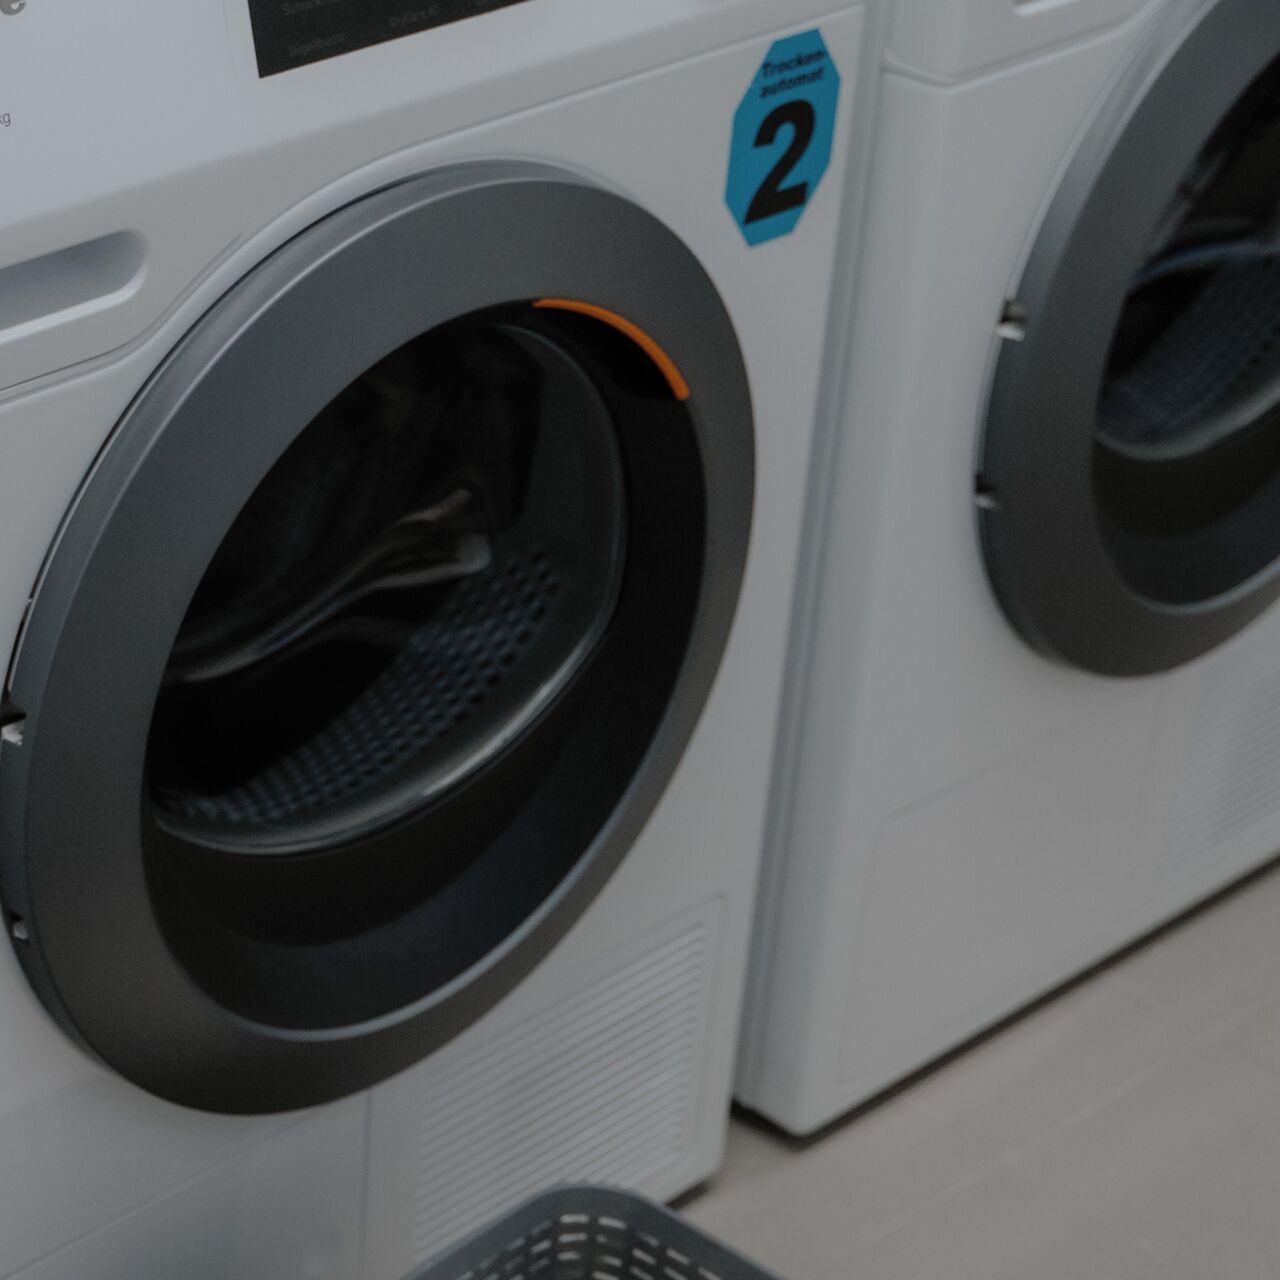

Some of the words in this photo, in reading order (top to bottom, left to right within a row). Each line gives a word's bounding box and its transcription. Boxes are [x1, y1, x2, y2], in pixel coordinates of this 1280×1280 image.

[760, 50, 827, 78] Trocken-
[760, 67, 824, 98] automat
[743, 99, 816, 225] 2
